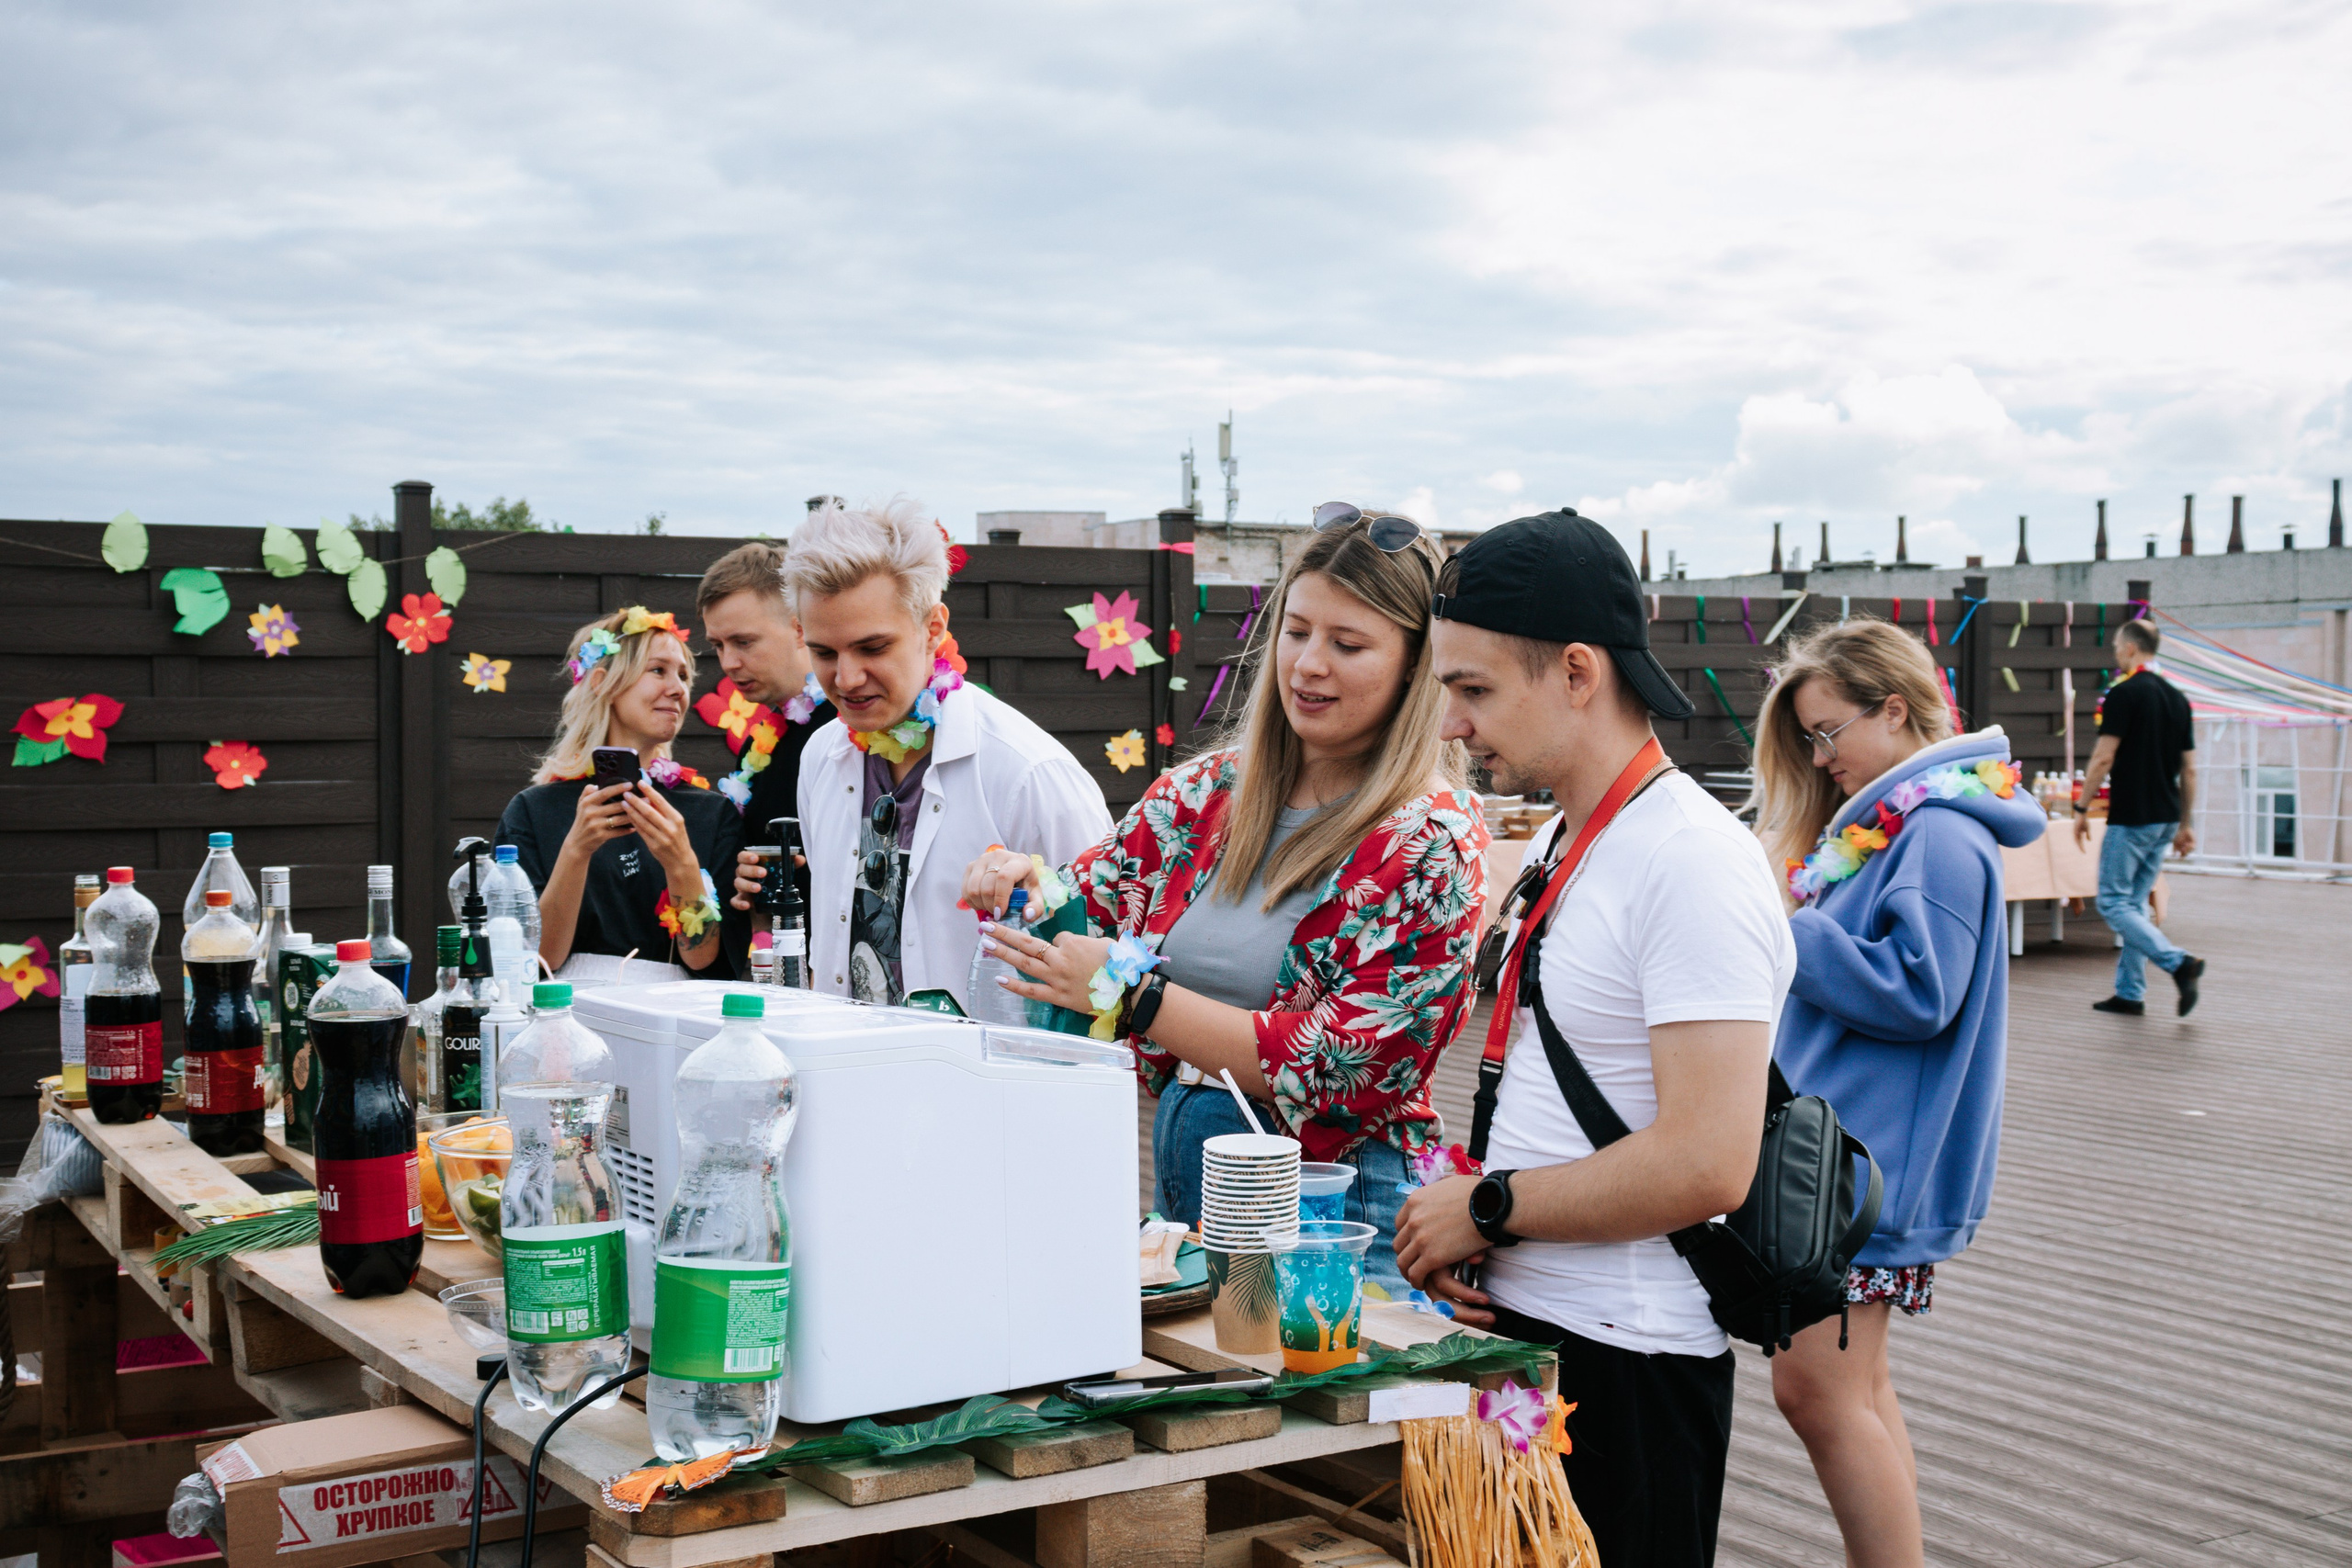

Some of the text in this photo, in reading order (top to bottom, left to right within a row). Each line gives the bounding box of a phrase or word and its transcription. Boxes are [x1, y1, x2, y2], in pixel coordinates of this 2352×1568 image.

[589, 1245, 601, 1327] ПЕРЕРАБАТЫВАЕМАЯ
[313, 1467, 455, 1512] ОСТОРОЖНО
[335, 1498, 435, 1538] ХРУПКОЕ
